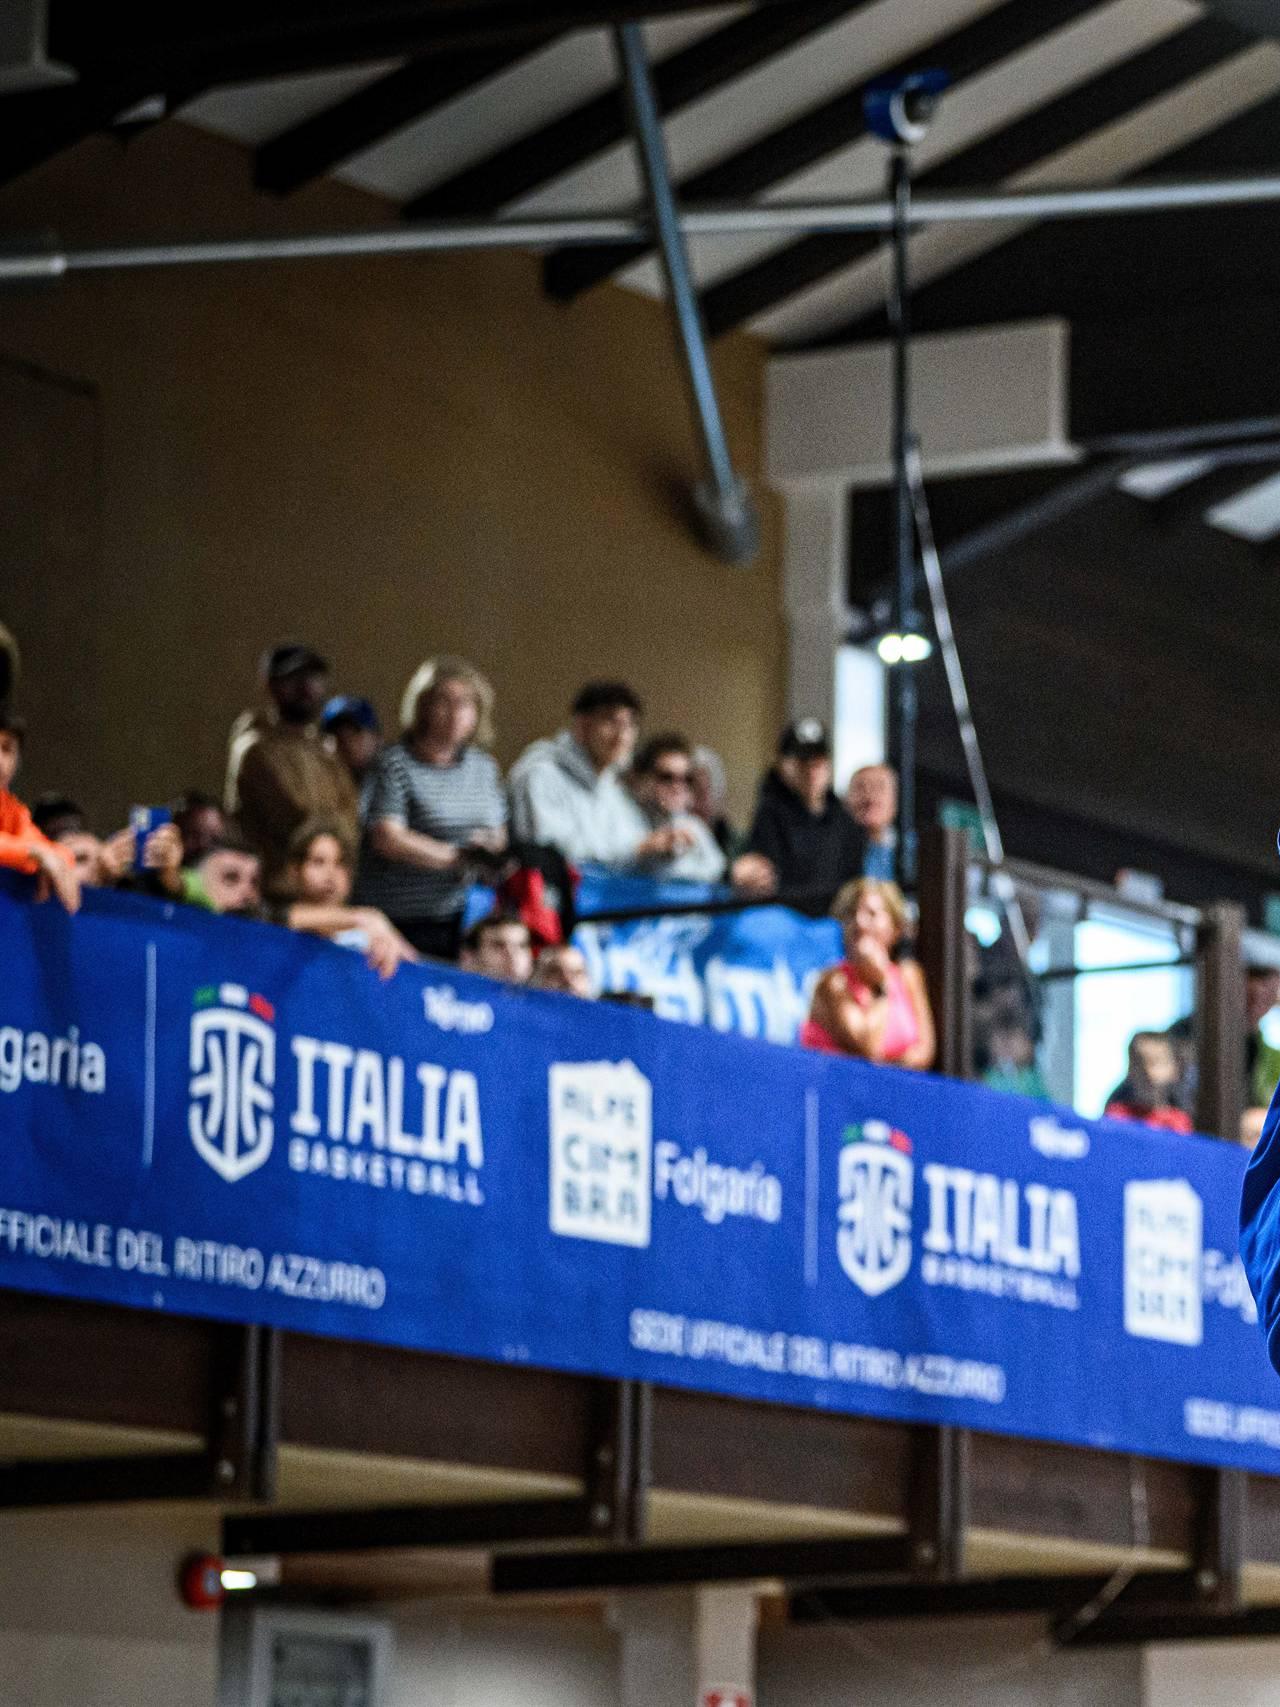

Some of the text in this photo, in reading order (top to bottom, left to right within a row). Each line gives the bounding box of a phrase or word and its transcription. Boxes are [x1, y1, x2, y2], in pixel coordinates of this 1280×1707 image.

[289, 1035, 484, 1170] ITALIA
[288, 1137, 486, 1206] BASKETBALL
[654, 1139, 782, 1224] Folgaria
[923, 1162, 1082, 1280] ITALIA
[115, 1226, 170, 1277] DEL
[173, 1236, 265, 1290] RITIRO
[264, 1252, 387, 1310] AZZURRO
